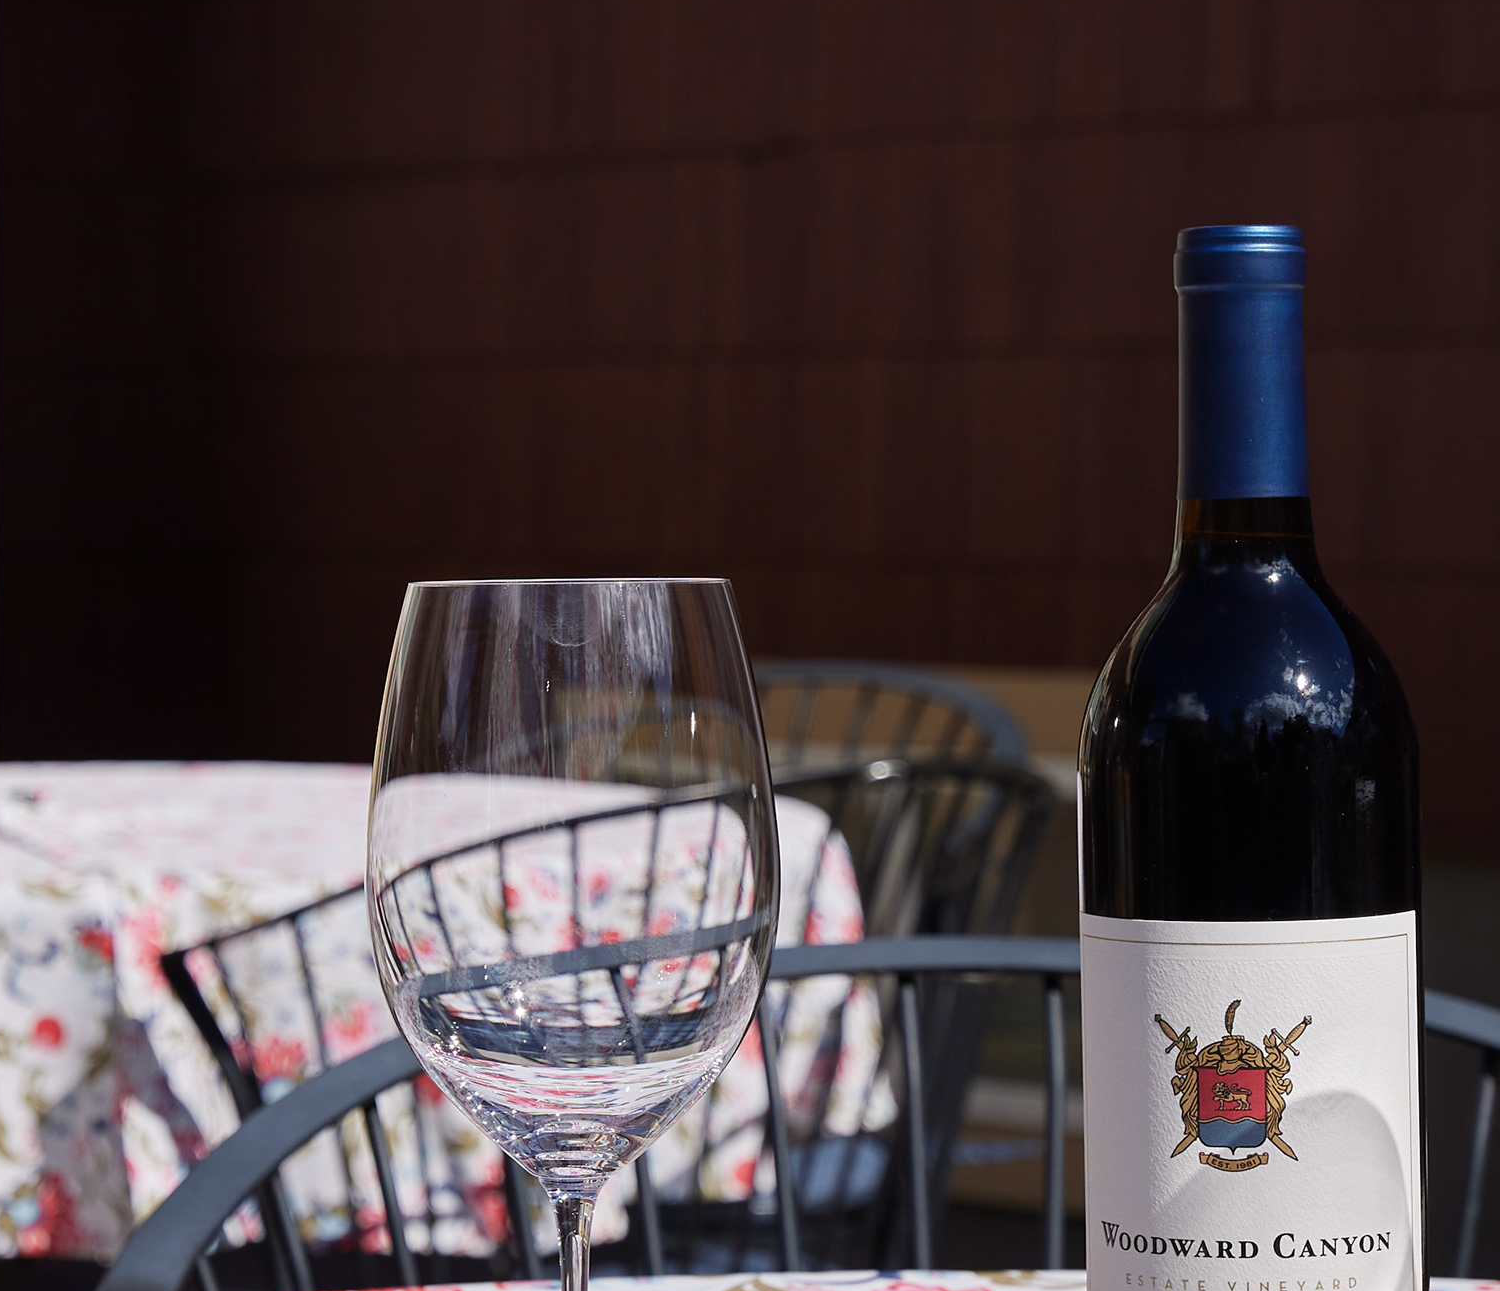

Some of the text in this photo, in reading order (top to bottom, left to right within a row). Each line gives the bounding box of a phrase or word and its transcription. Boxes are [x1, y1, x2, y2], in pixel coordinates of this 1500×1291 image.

[1210, 1159, 1257, 1170] EST. 1981
[1101, 1220, 1391, 1259] WOODWARD CANYON
[1126, 1273, 1206, 1291] ESTATE
